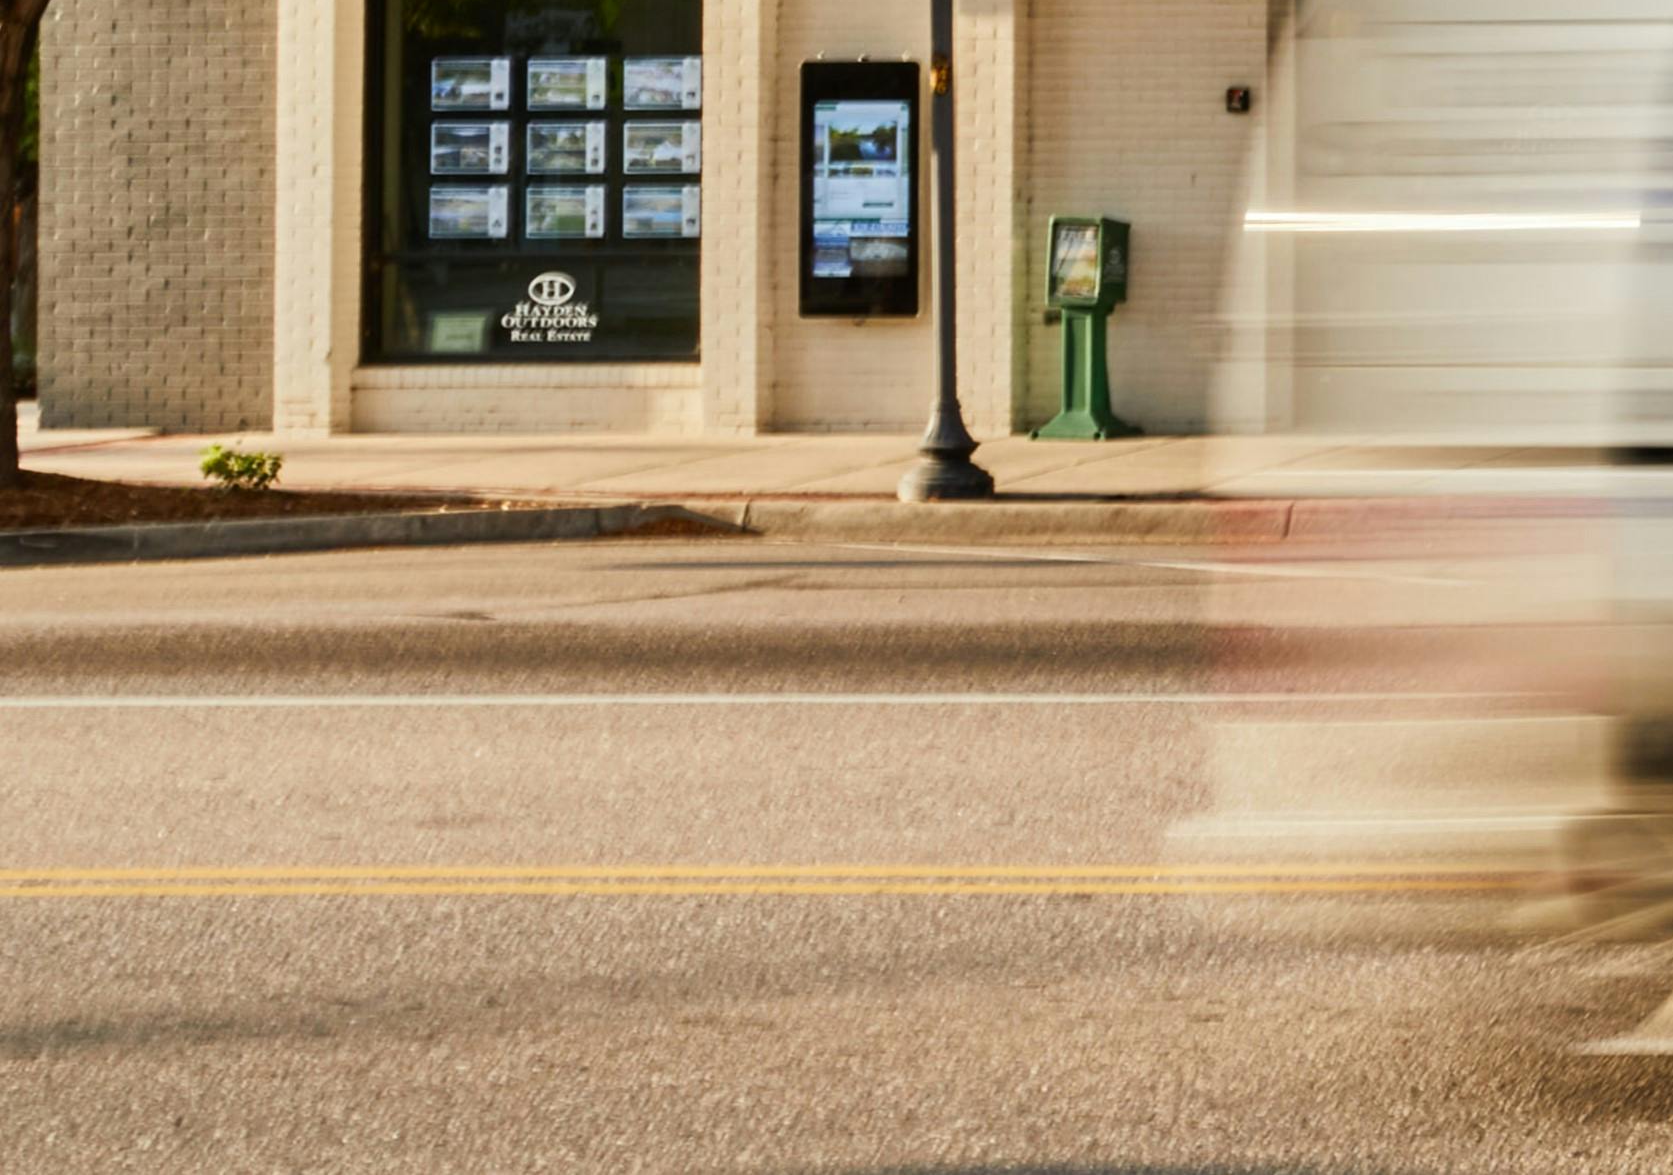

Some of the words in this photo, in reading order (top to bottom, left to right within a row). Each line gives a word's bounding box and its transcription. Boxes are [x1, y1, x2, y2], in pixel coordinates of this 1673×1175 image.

[514, 303, 588, 316] HAYDEN
[501, 314, 599, 329] OUTDOORS
[511, 330, 543, 342] REAL
[547, 330, 592, 342] ESTATE
